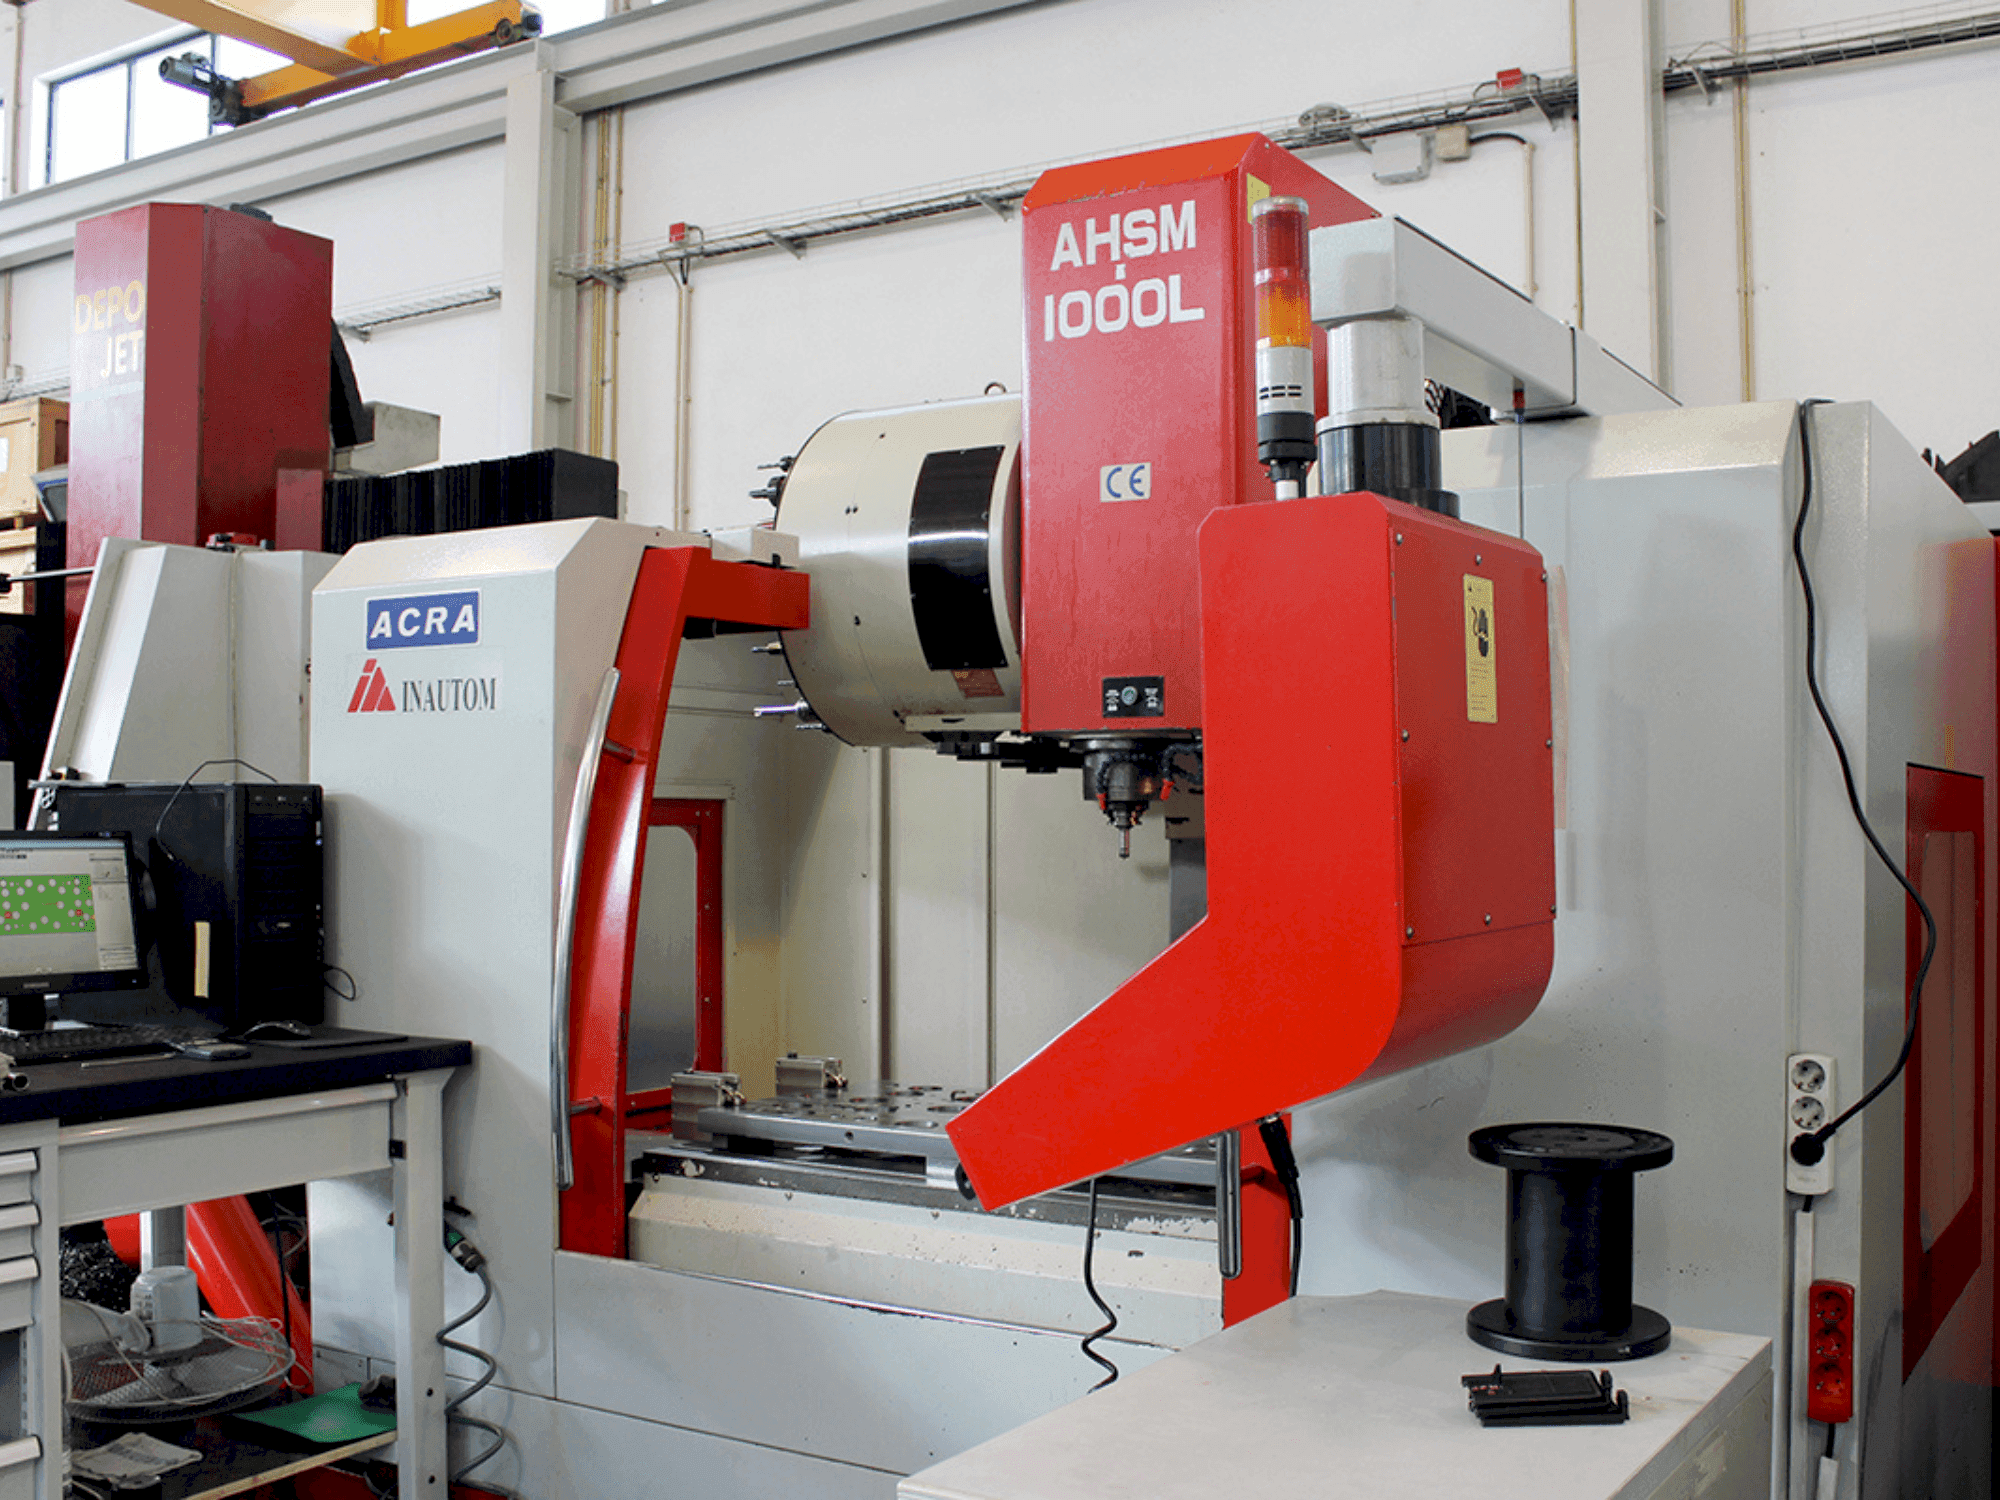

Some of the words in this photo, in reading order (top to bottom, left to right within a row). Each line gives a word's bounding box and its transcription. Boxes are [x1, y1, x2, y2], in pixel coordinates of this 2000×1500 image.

[1050, 200, 1196, 271] AHSM
[75, 280, 145, 335] DEPO
[1044, 274, 1205, 342] 1000L
[100, 330, 143, 377] JET
[1107, 465, 1145, 498] CE
[370, 604, 475, 638] ACRA
[402, 678, 496, 713] INAUTOM
